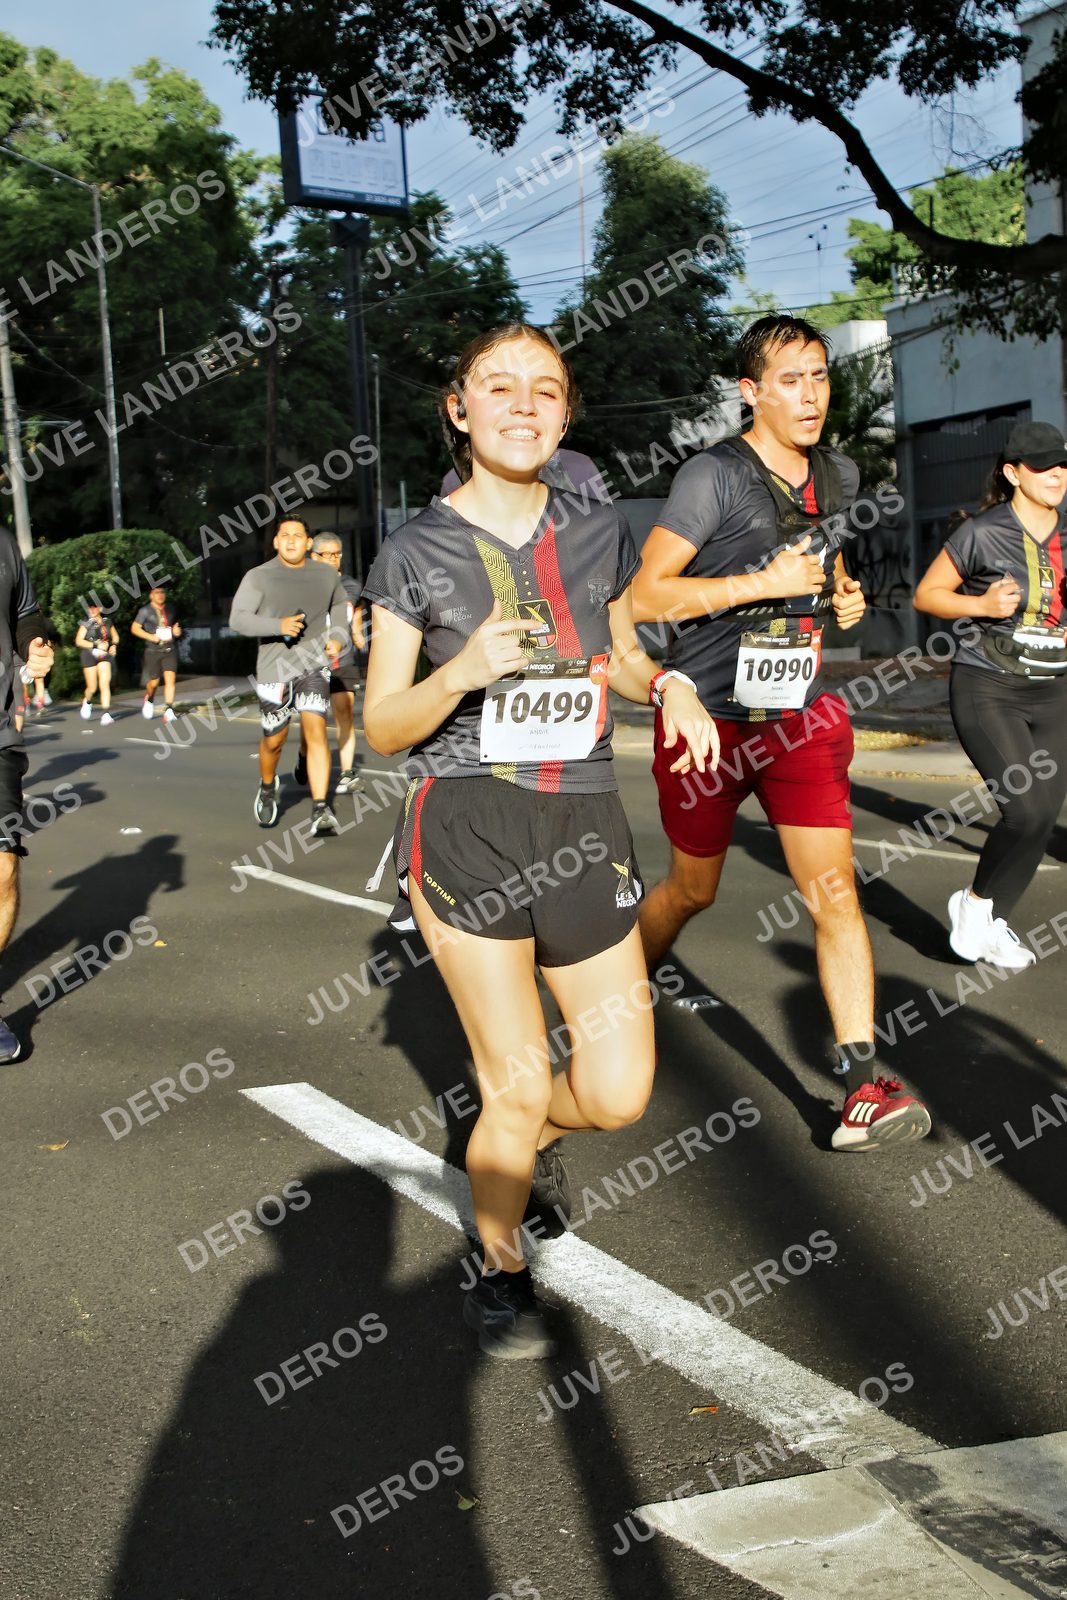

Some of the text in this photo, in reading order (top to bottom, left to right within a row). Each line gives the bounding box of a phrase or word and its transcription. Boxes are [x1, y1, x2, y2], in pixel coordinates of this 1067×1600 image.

[744, 656, 813, 682] 10990
[491, 690, 593, 724] 10499
[423, 871, 457, 906] TOPTIME
